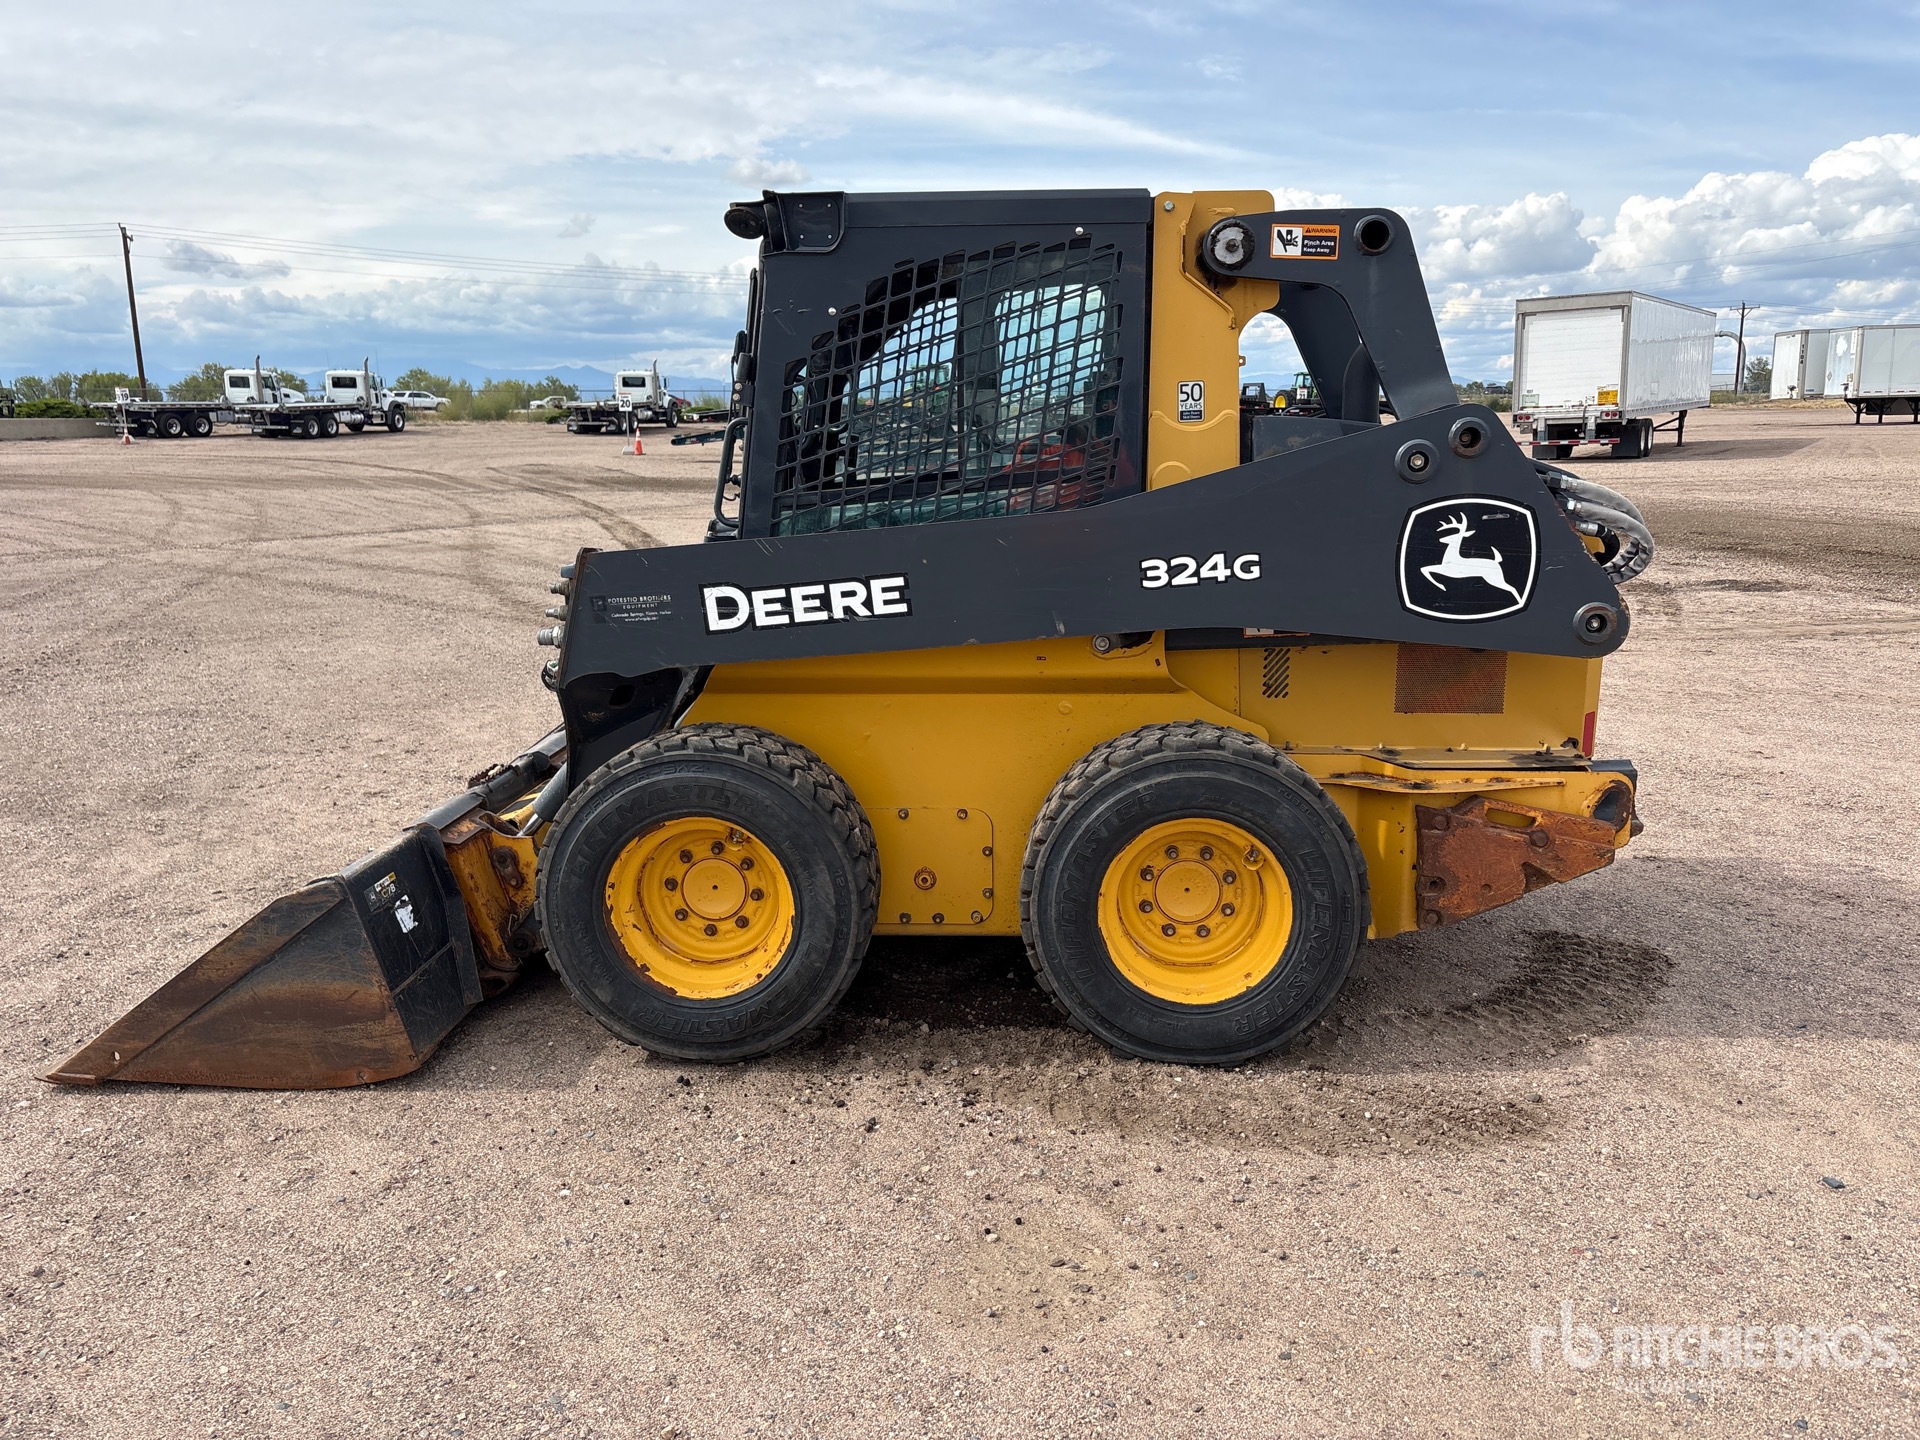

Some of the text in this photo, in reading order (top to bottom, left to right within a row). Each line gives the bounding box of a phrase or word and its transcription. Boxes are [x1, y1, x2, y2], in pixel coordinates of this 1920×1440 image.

[1180, 383, 1202, 402] 50
[620, 399, 631, 408] 20
[1180, 402, 1202, 410] YEARS
[1141, 553, 1260, 588] 324G
[622, 602, 658, 610] EQUIPMENT
[702, 576, 909, 632] DEERE
